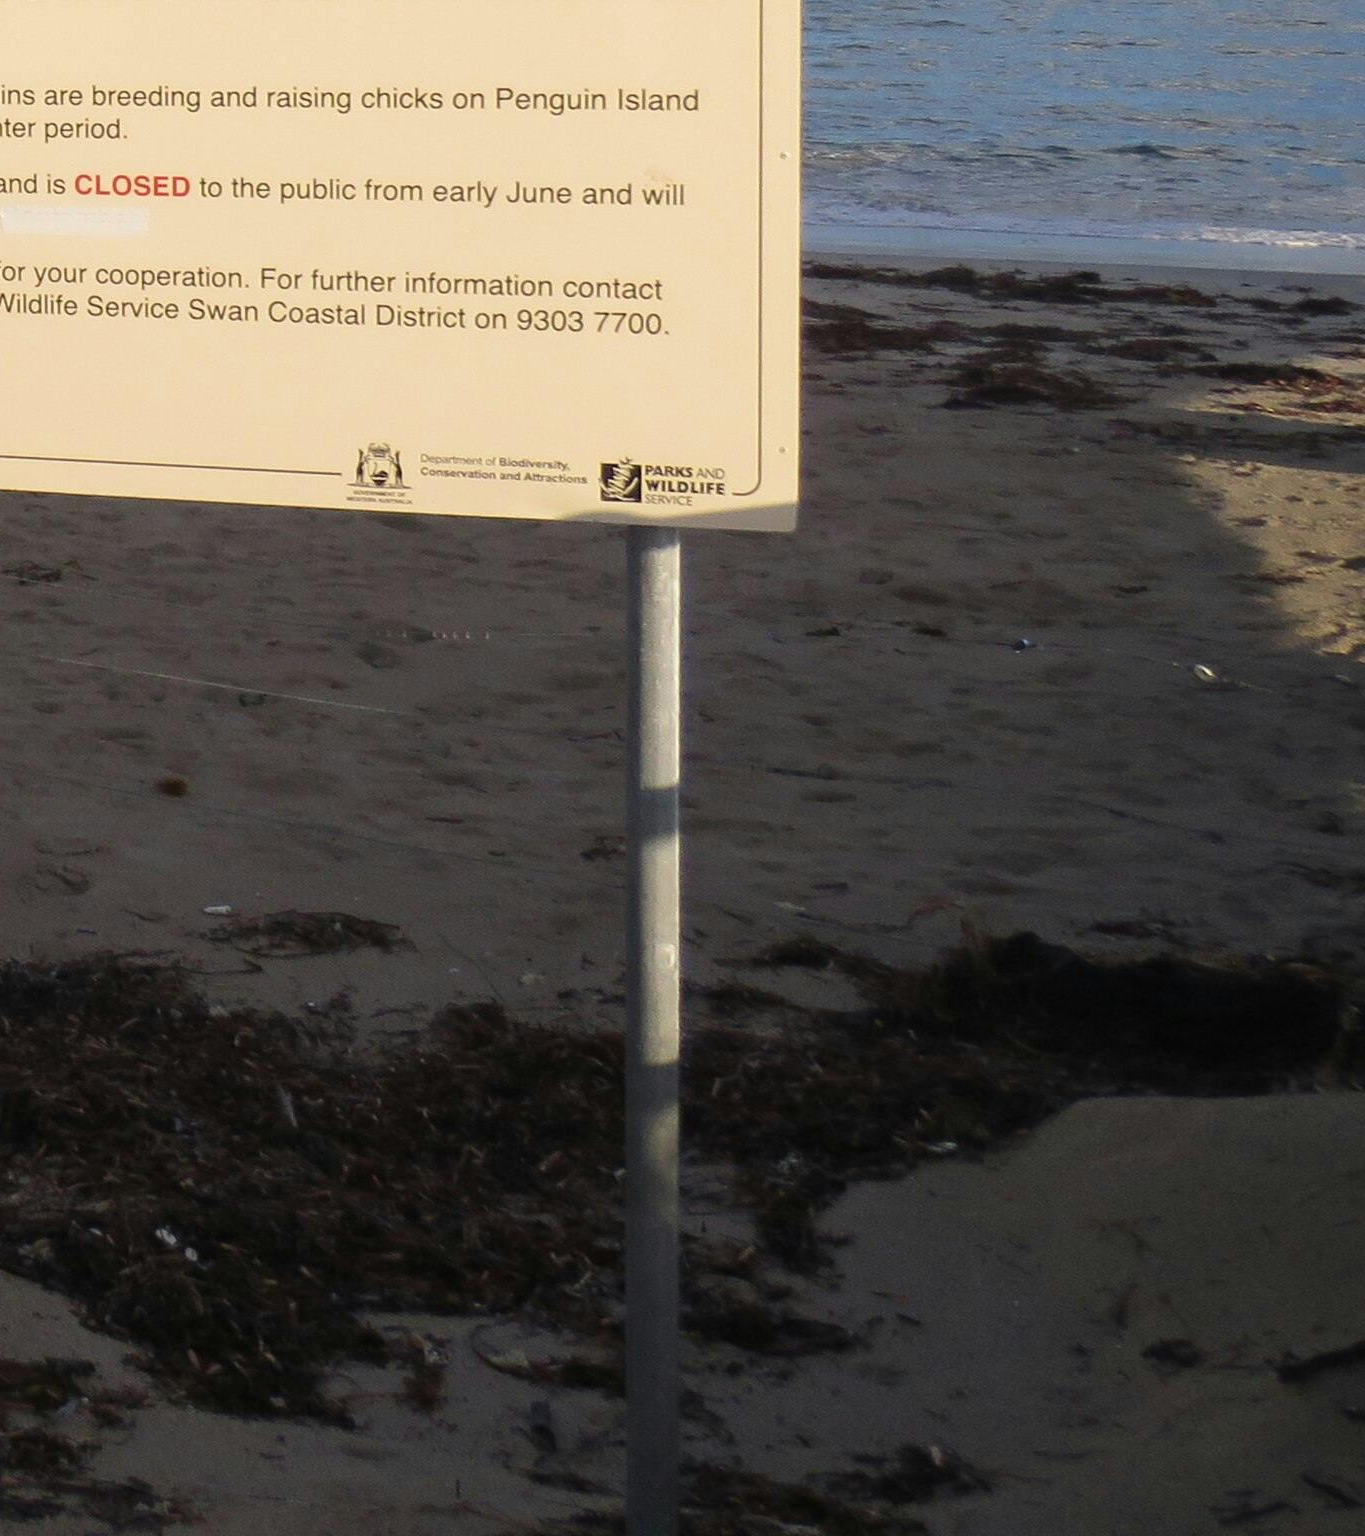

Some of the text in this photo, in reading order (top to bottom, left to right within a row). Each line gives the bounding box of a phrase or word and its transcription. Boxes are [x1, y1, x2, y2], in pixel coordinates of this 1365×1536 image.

[43, 89, 84, 107] are
[92, 84, 201, 113] breeding
[210, 85, 258, 109] and
[266, 86, 352, 115] raising
[360, 86, 444, 110] chicks
[452, 92, 485, 110] on
[495, 87, 607, 117] Penguin
[617, 88, 699, 112] Island
[44, 117, 128, 144] period.
[46, 173, 67, 195] is
[74, 173, 191, 198] CLOSED
[198, 177, 223, 198] to
[230, 176, 271, 200] the
[280, 177, 357, 205] public
[364, 178, 423, 202] from
[432, 180, 498, 209] early
[505, 181, 573, 205] June
[581, 182, 633, 206] and
[641, 183, 685, 207] will
[32, 265, 88, 288] your
[95, 266, 250, 291] cooperation.
[260, 267, 303, 290] For
[310, 268, 397, 293] further
[405, 271, 553, 297] information
[562, 277, 663, 301] contact
[86, 294, 180, 320] Service
[188, 298, 259, 322] Swan
[267, 300, 366, 326] Coastal
[376, 303, 466, 329] District
[474, 312, 507, 330] on
[516, 308, 585, 333] 9303
[593, 311, 670, 336] 7700.
[420, 454, 570, 470] Department of Biodiversity,
[645, 465, 725, 479] PARKS AND
[420, 467, 587, 484] Conservation and Attractions
[645, 480, 726, 495] WILDLIFE
[645, 494, 693, 506] SERVICE
